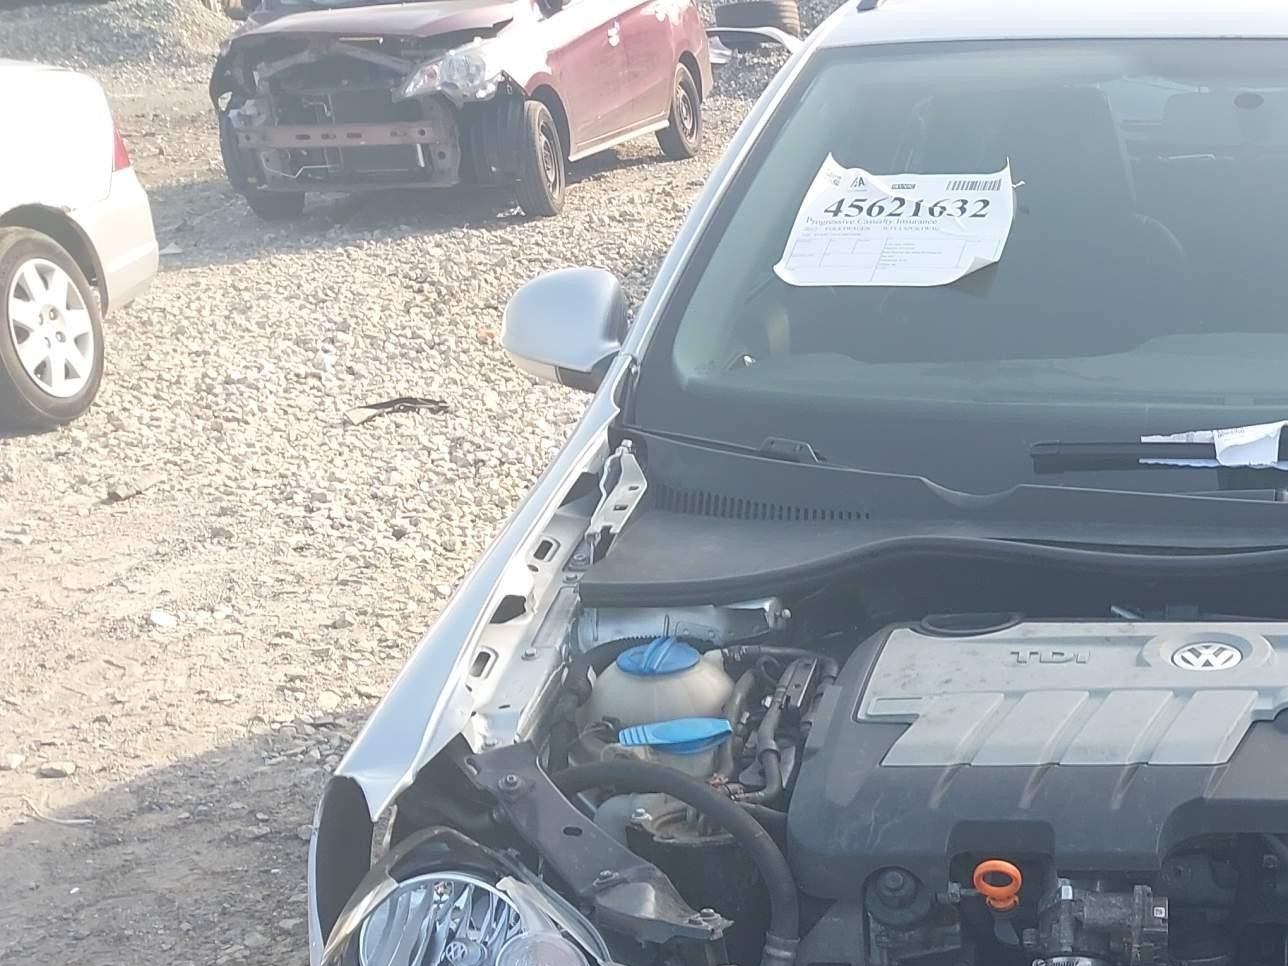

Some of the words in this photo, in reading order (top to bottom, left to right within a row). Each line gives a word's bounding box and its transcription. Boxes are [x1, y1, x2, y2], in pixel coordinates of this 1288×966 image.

[823, 197, 991, 218] 45621632
[1010, 651, 1090, 665] TDI
[1171, 641, 1243, 671] VW
